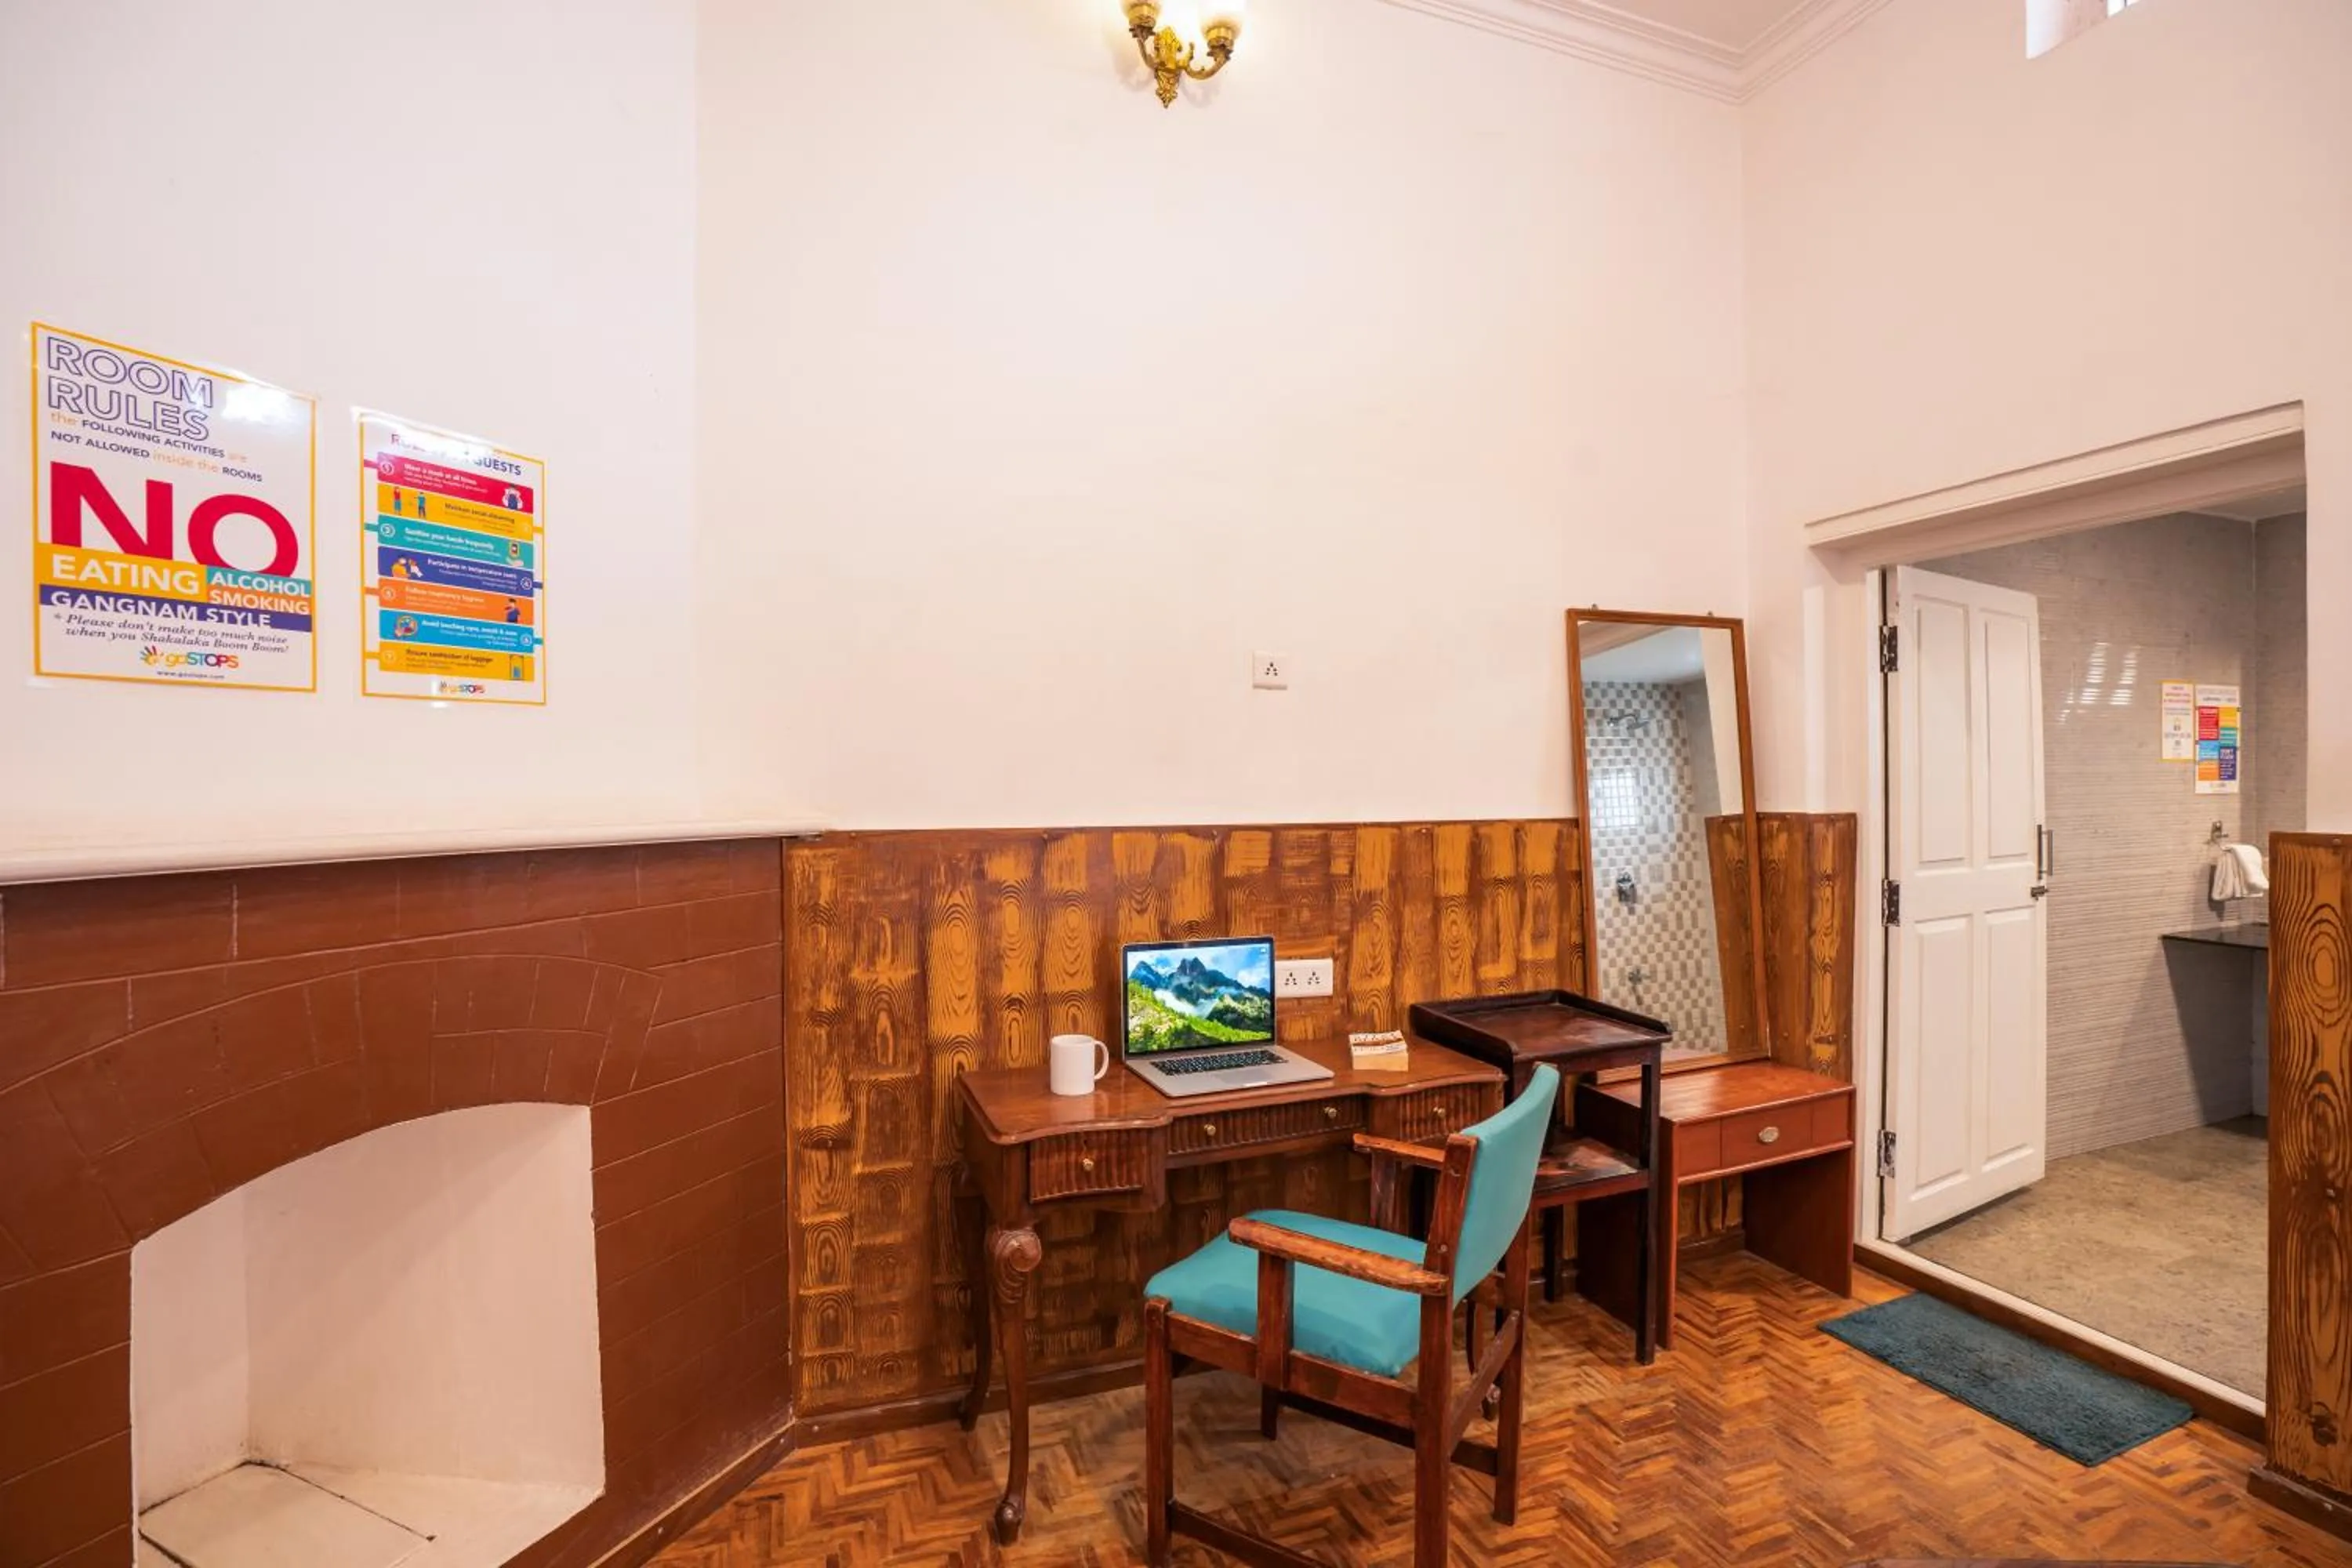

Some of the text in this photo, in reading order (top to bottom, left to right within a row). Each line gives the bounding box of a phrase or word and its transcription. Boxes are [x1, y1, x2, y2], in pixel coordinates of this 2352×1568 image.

[47, 336, 213, 408] ROOM
[49, 376, 209, 441] RULES
[50, 412, 76, 425] the
[82, 419, 160, 444] FOLLOWING
[164, 438, 225, 458] ACTIVITIES
[51, 430, 263, 481] NOT ALLOWED inside the ROOMS
[50, 461, 299, 579] NO
[52, 554, 199, 595] EATING
[210, 572, 310, 597] ALCOHOL
[51, 590, 271, 628] GANGNAM STYLE
[209, 589, 310, 615] SMOKING
[66, 614, 288, 644] Please don't make too much noise
[66, 626, 106, 637] when
[111, 632, 136, 641] you
[141, 631, 210, 647] Shakalaka
[214, 639, 249, 651] Boom
[165, 652, 239, 669] goSTOPS
